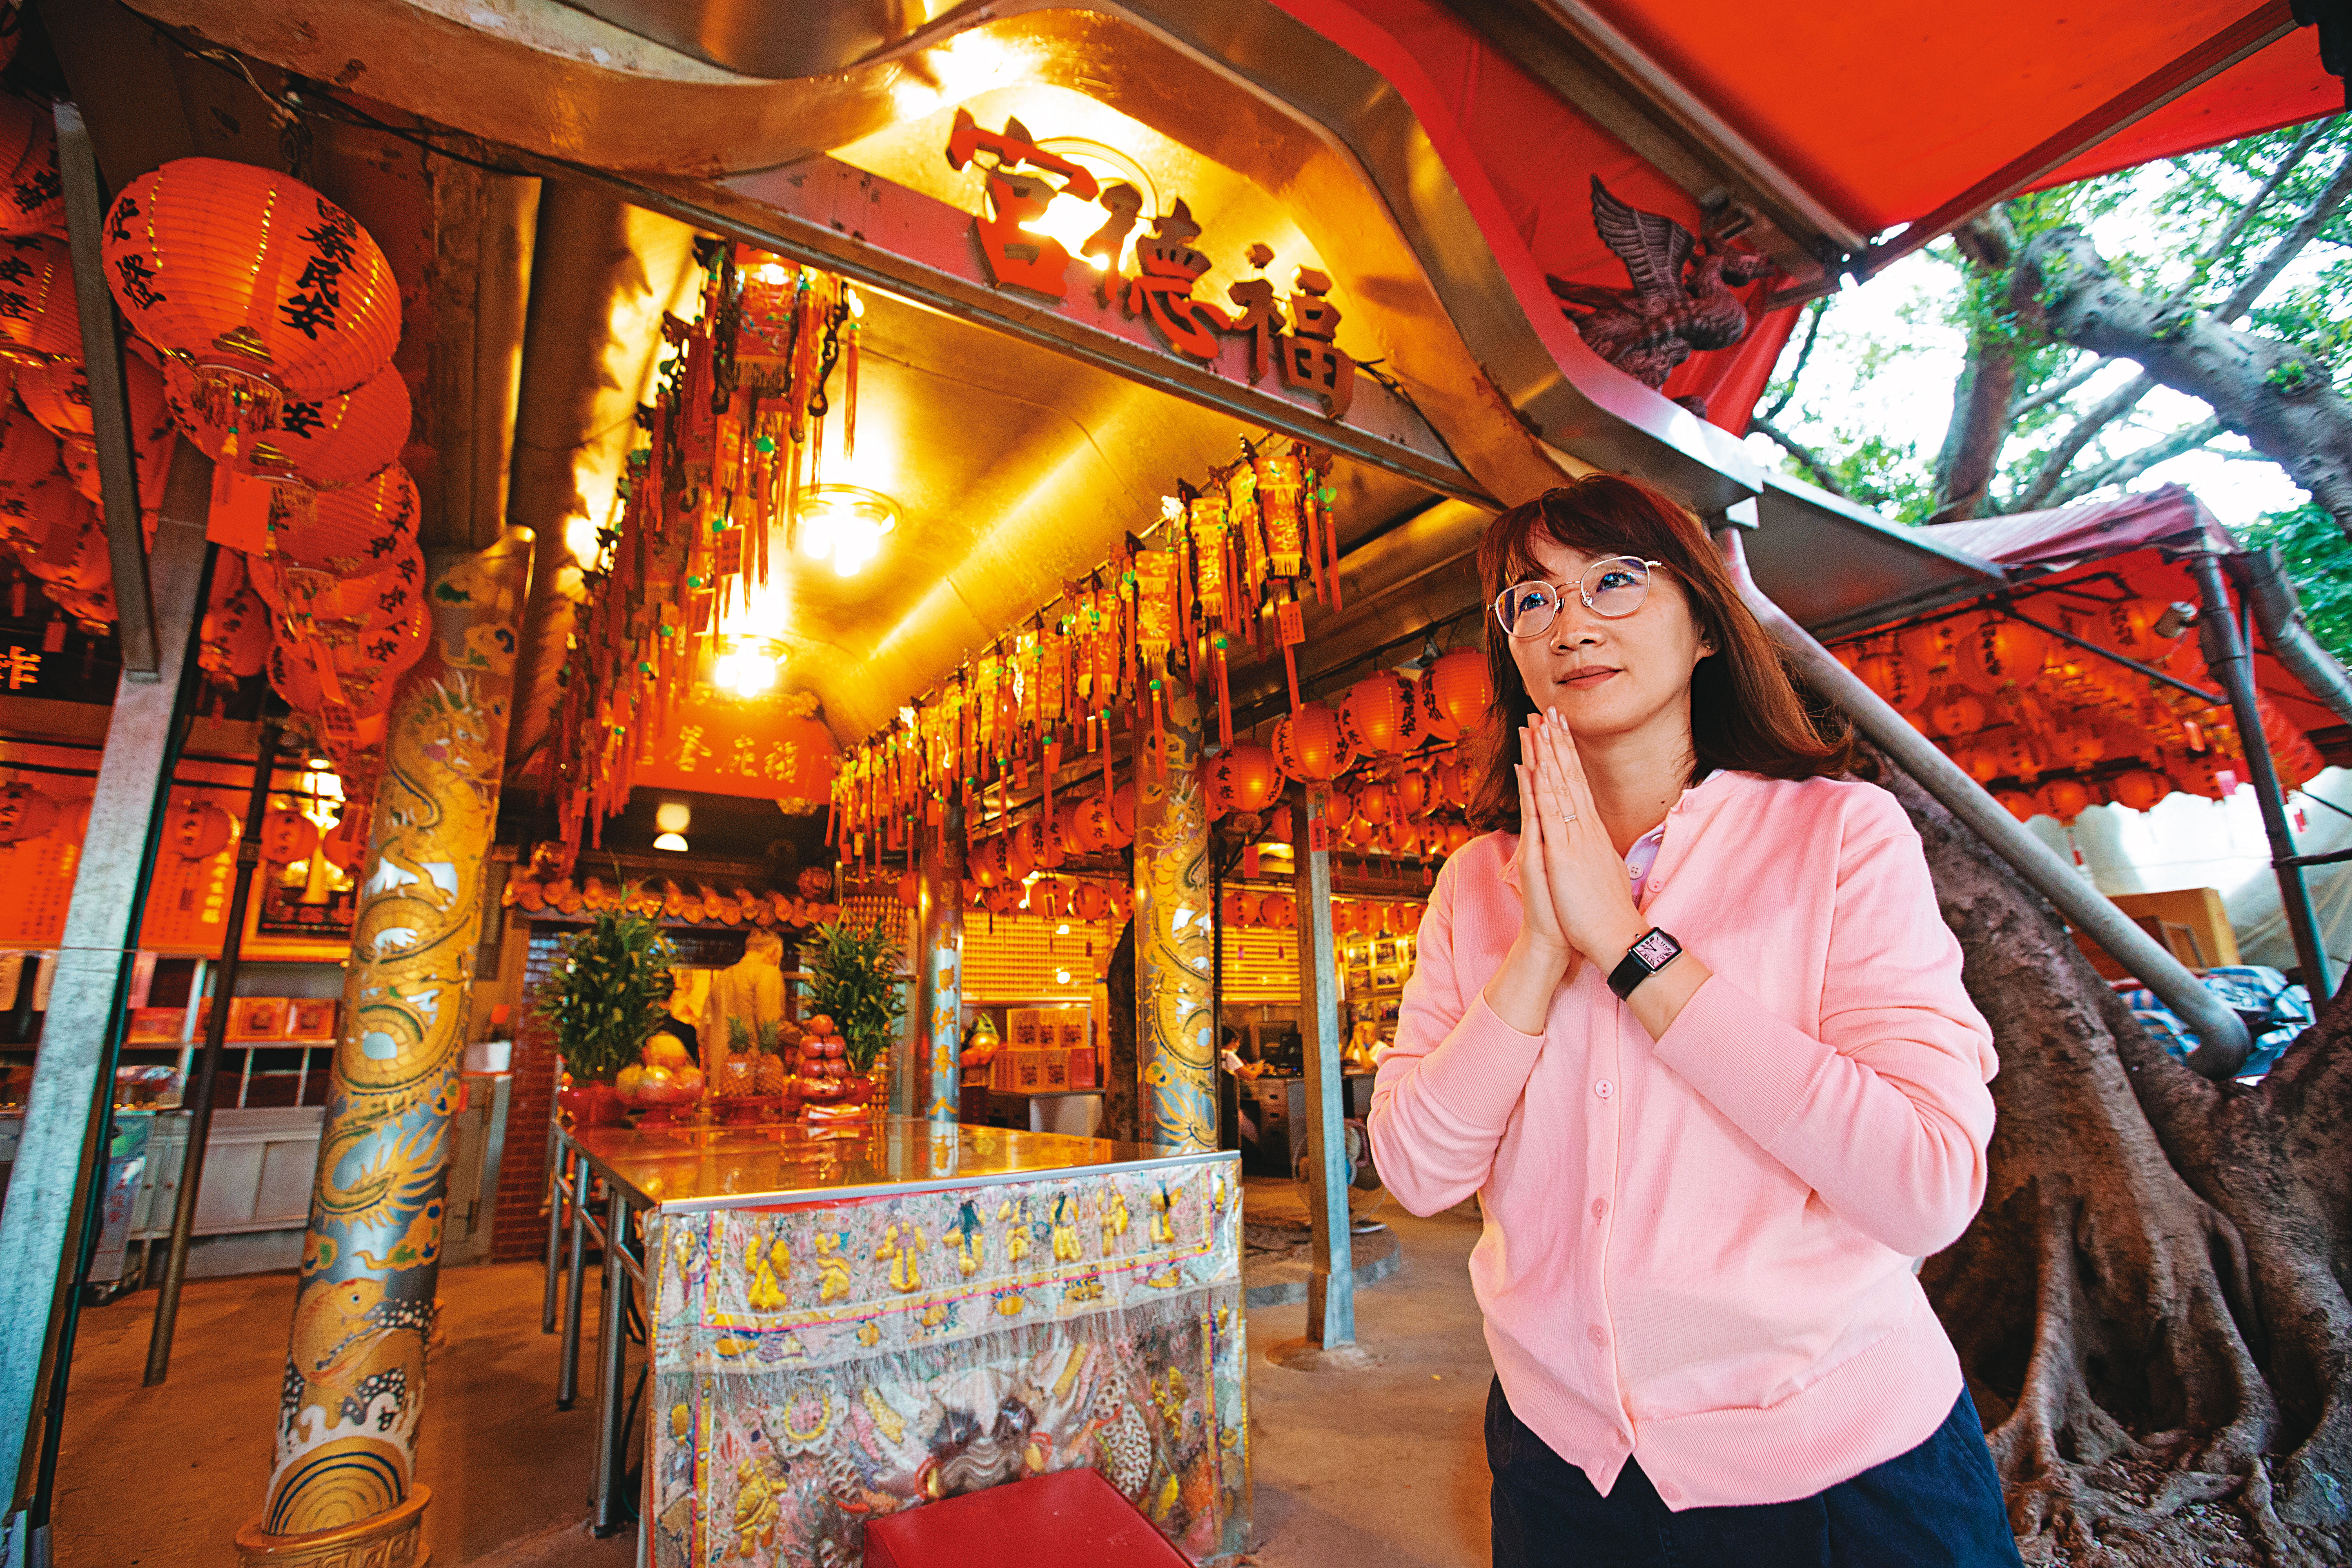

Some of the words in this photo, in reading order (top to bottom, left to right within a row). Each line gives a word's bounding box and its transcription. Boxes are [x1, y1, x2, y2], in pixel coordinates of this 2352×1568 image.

[278, 198, 358, 340] 國泰民安
[946, 107, 1356, 422] 福德宮
